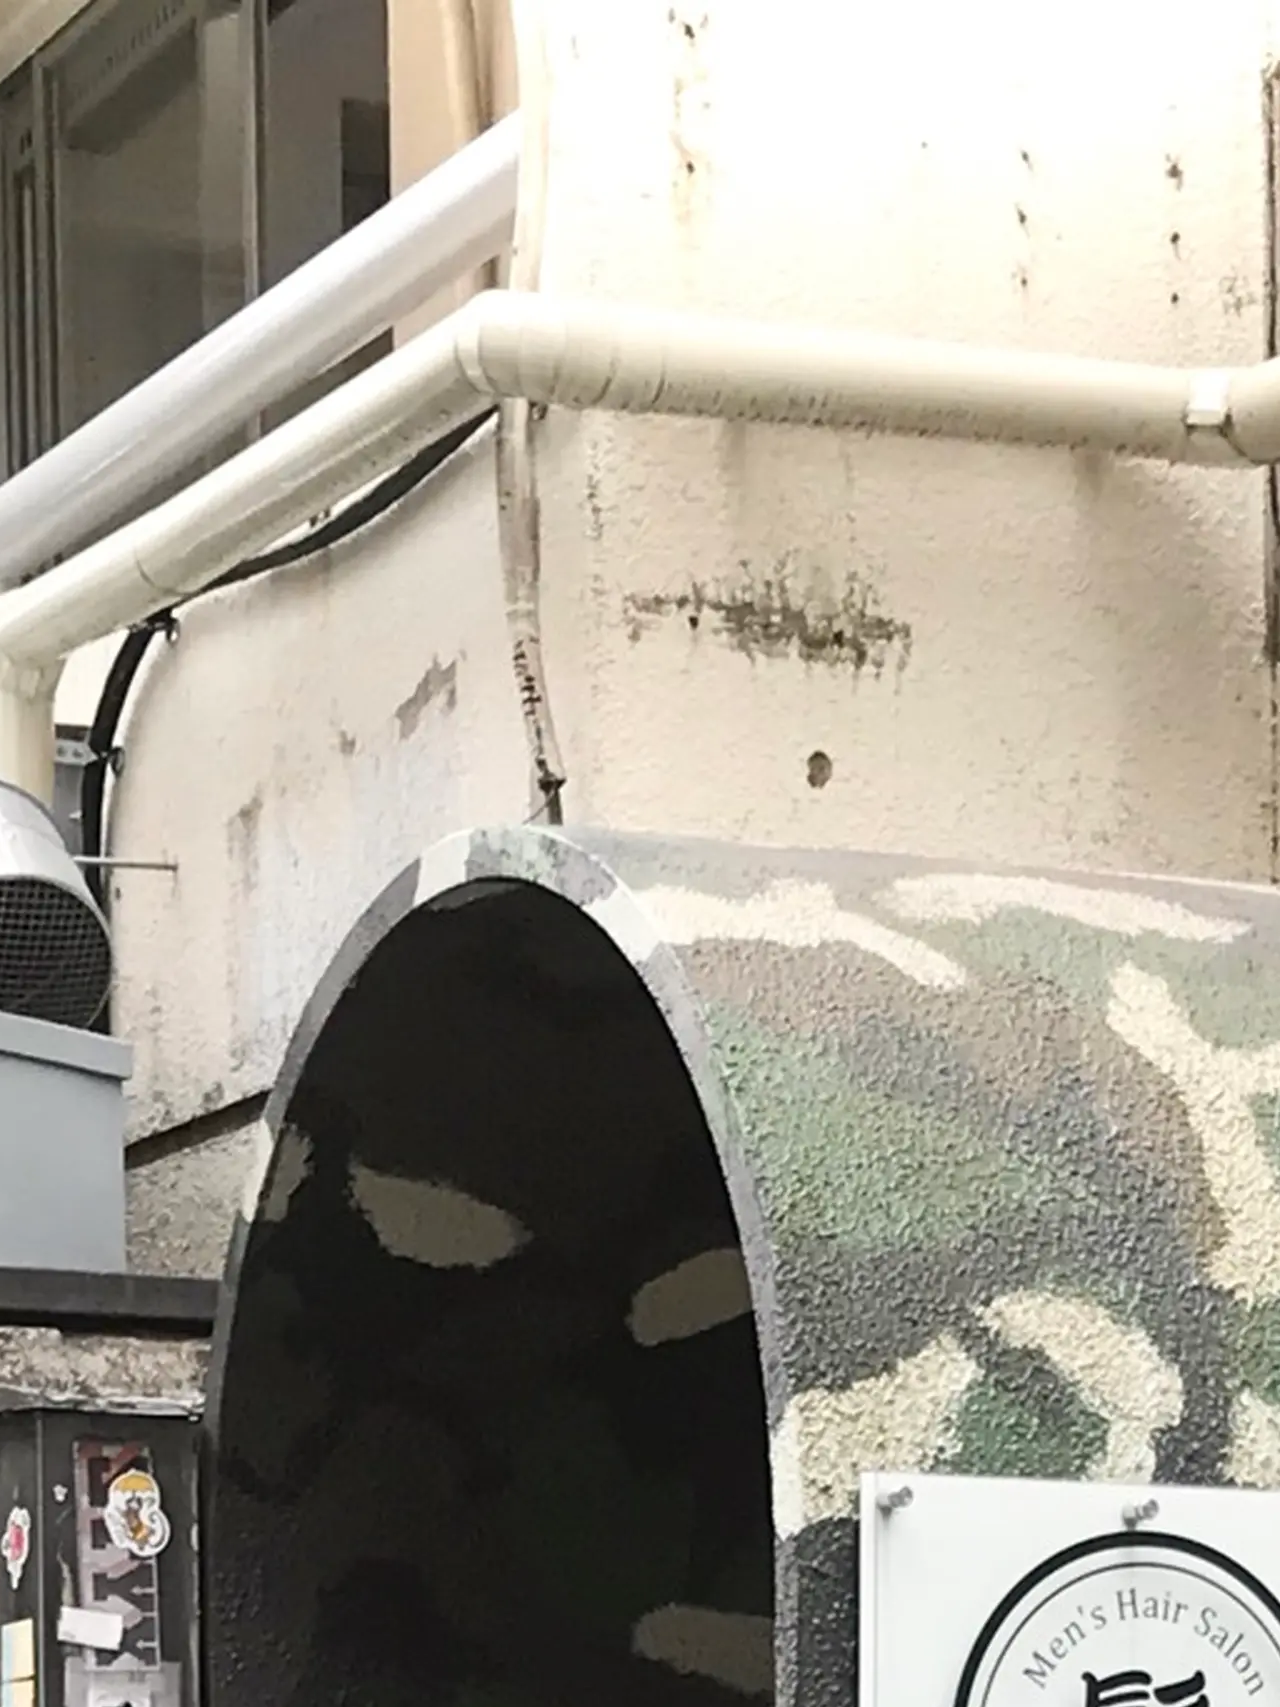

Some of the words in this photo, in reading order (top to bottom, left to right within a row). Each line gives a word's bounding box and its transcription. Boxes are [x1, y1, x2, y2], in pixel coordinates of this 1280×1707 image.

[1022, 1604, 1108, 1690] Men's
[1116, 1587, 1189, 1625] Hair
[1193, 1606, 1266, 1697] Salon
